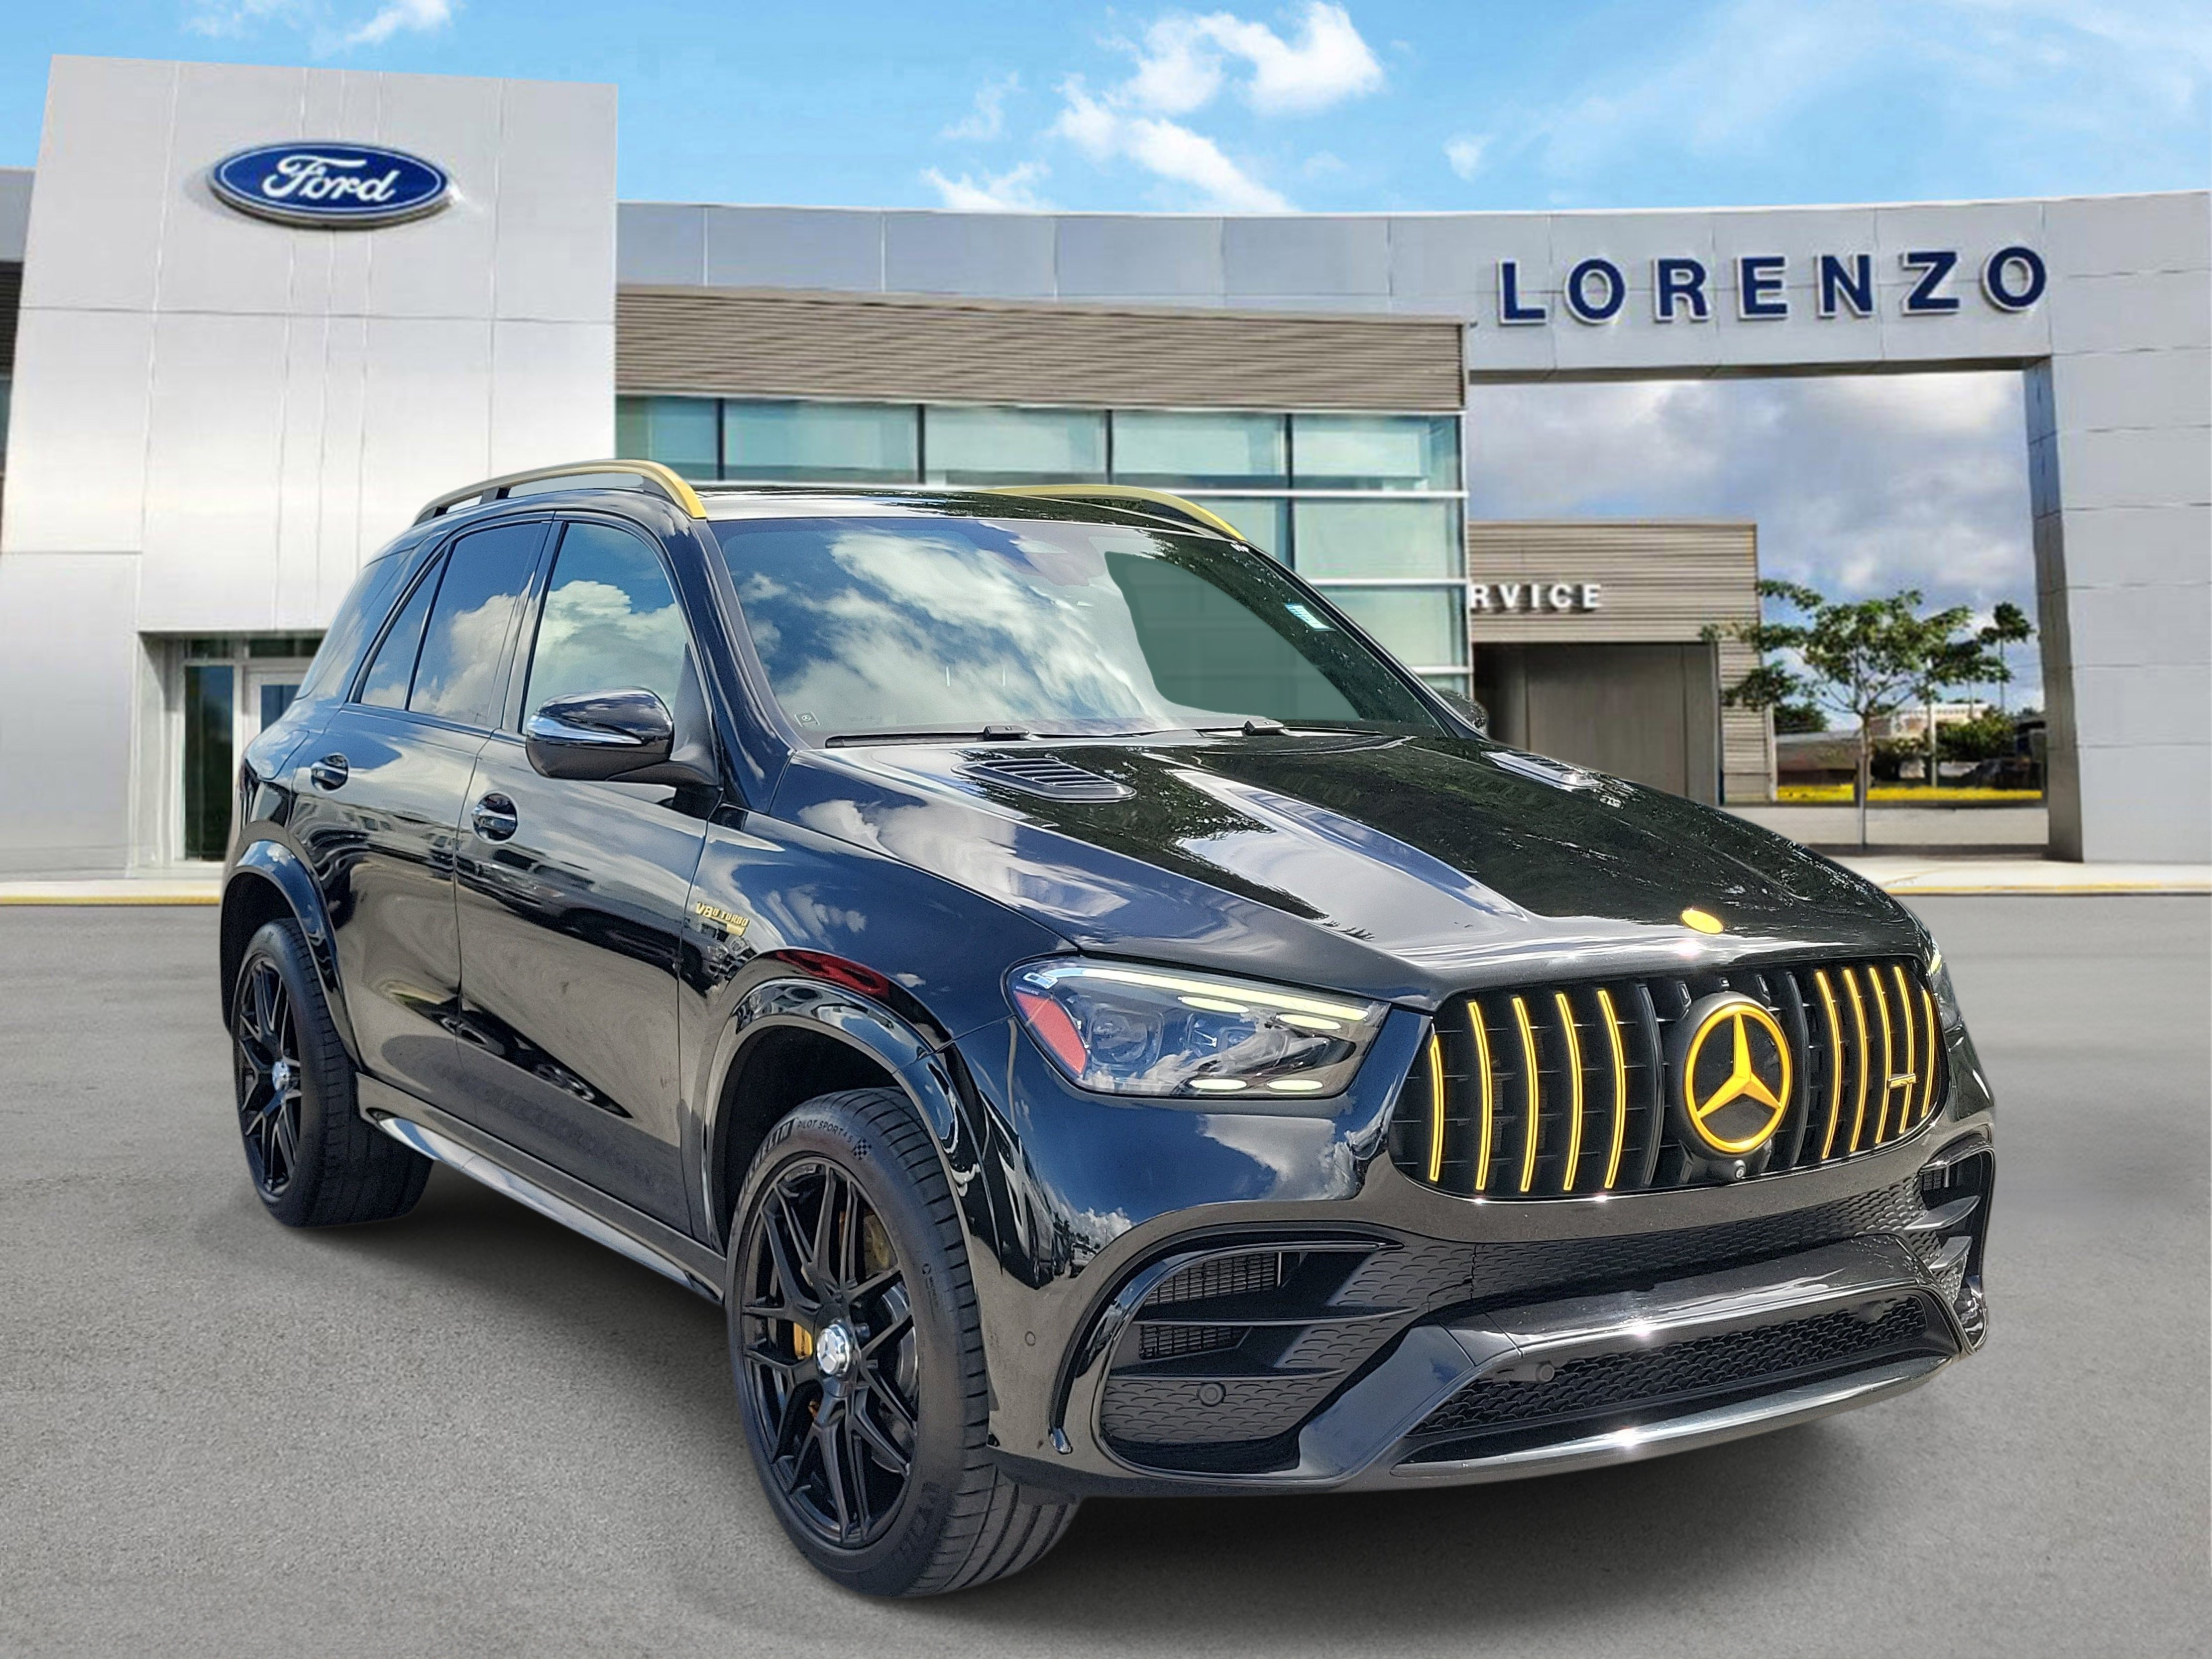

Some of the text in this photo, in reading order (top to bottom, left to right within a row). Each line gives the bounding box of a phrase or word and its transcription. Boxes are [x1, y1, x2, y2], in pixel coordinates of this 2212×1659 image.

[262, 154, 400, 202] Ford
[1498, 245, 2047, 327] LORENZO
[818, 1120, 844, 1135] SPORT
